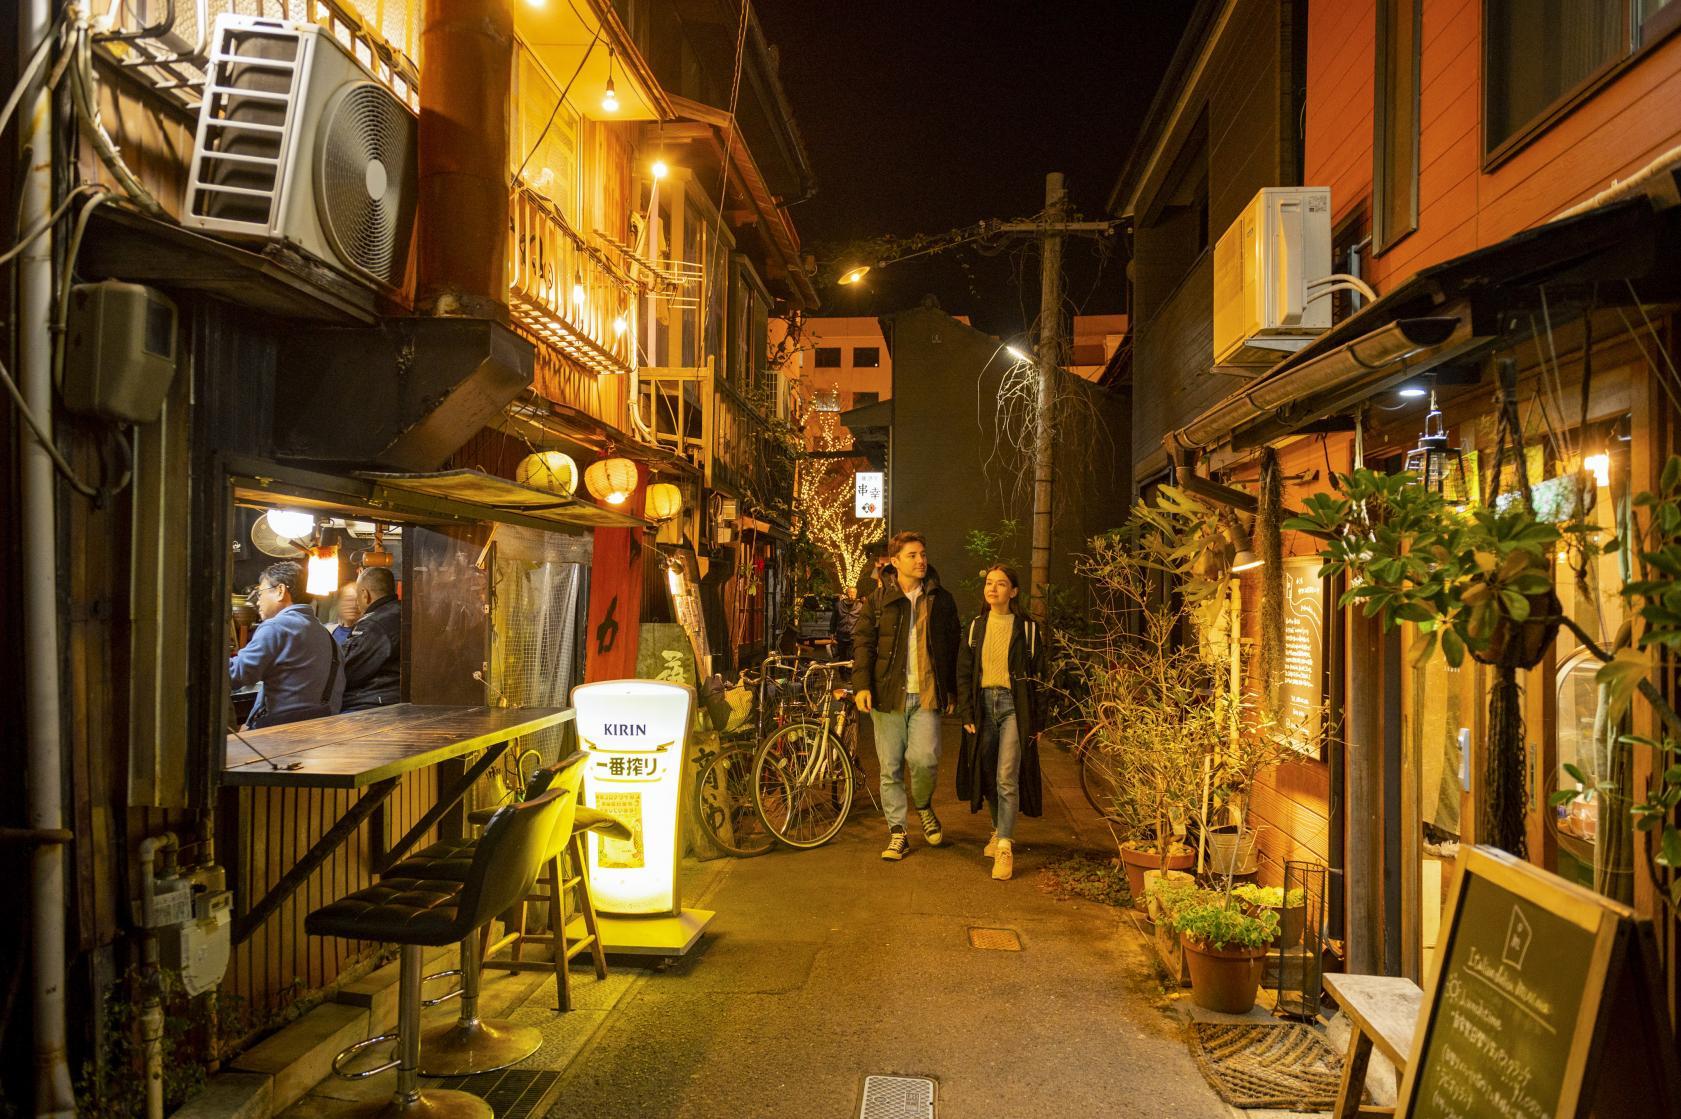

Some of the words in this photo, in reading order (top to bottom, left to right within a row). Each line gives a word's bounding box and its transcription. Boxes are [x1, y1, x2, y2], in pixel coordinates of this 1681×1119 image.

[604, 723, 646, 736] KIRIN
[596, 757, 657, 776] 一番搾り
